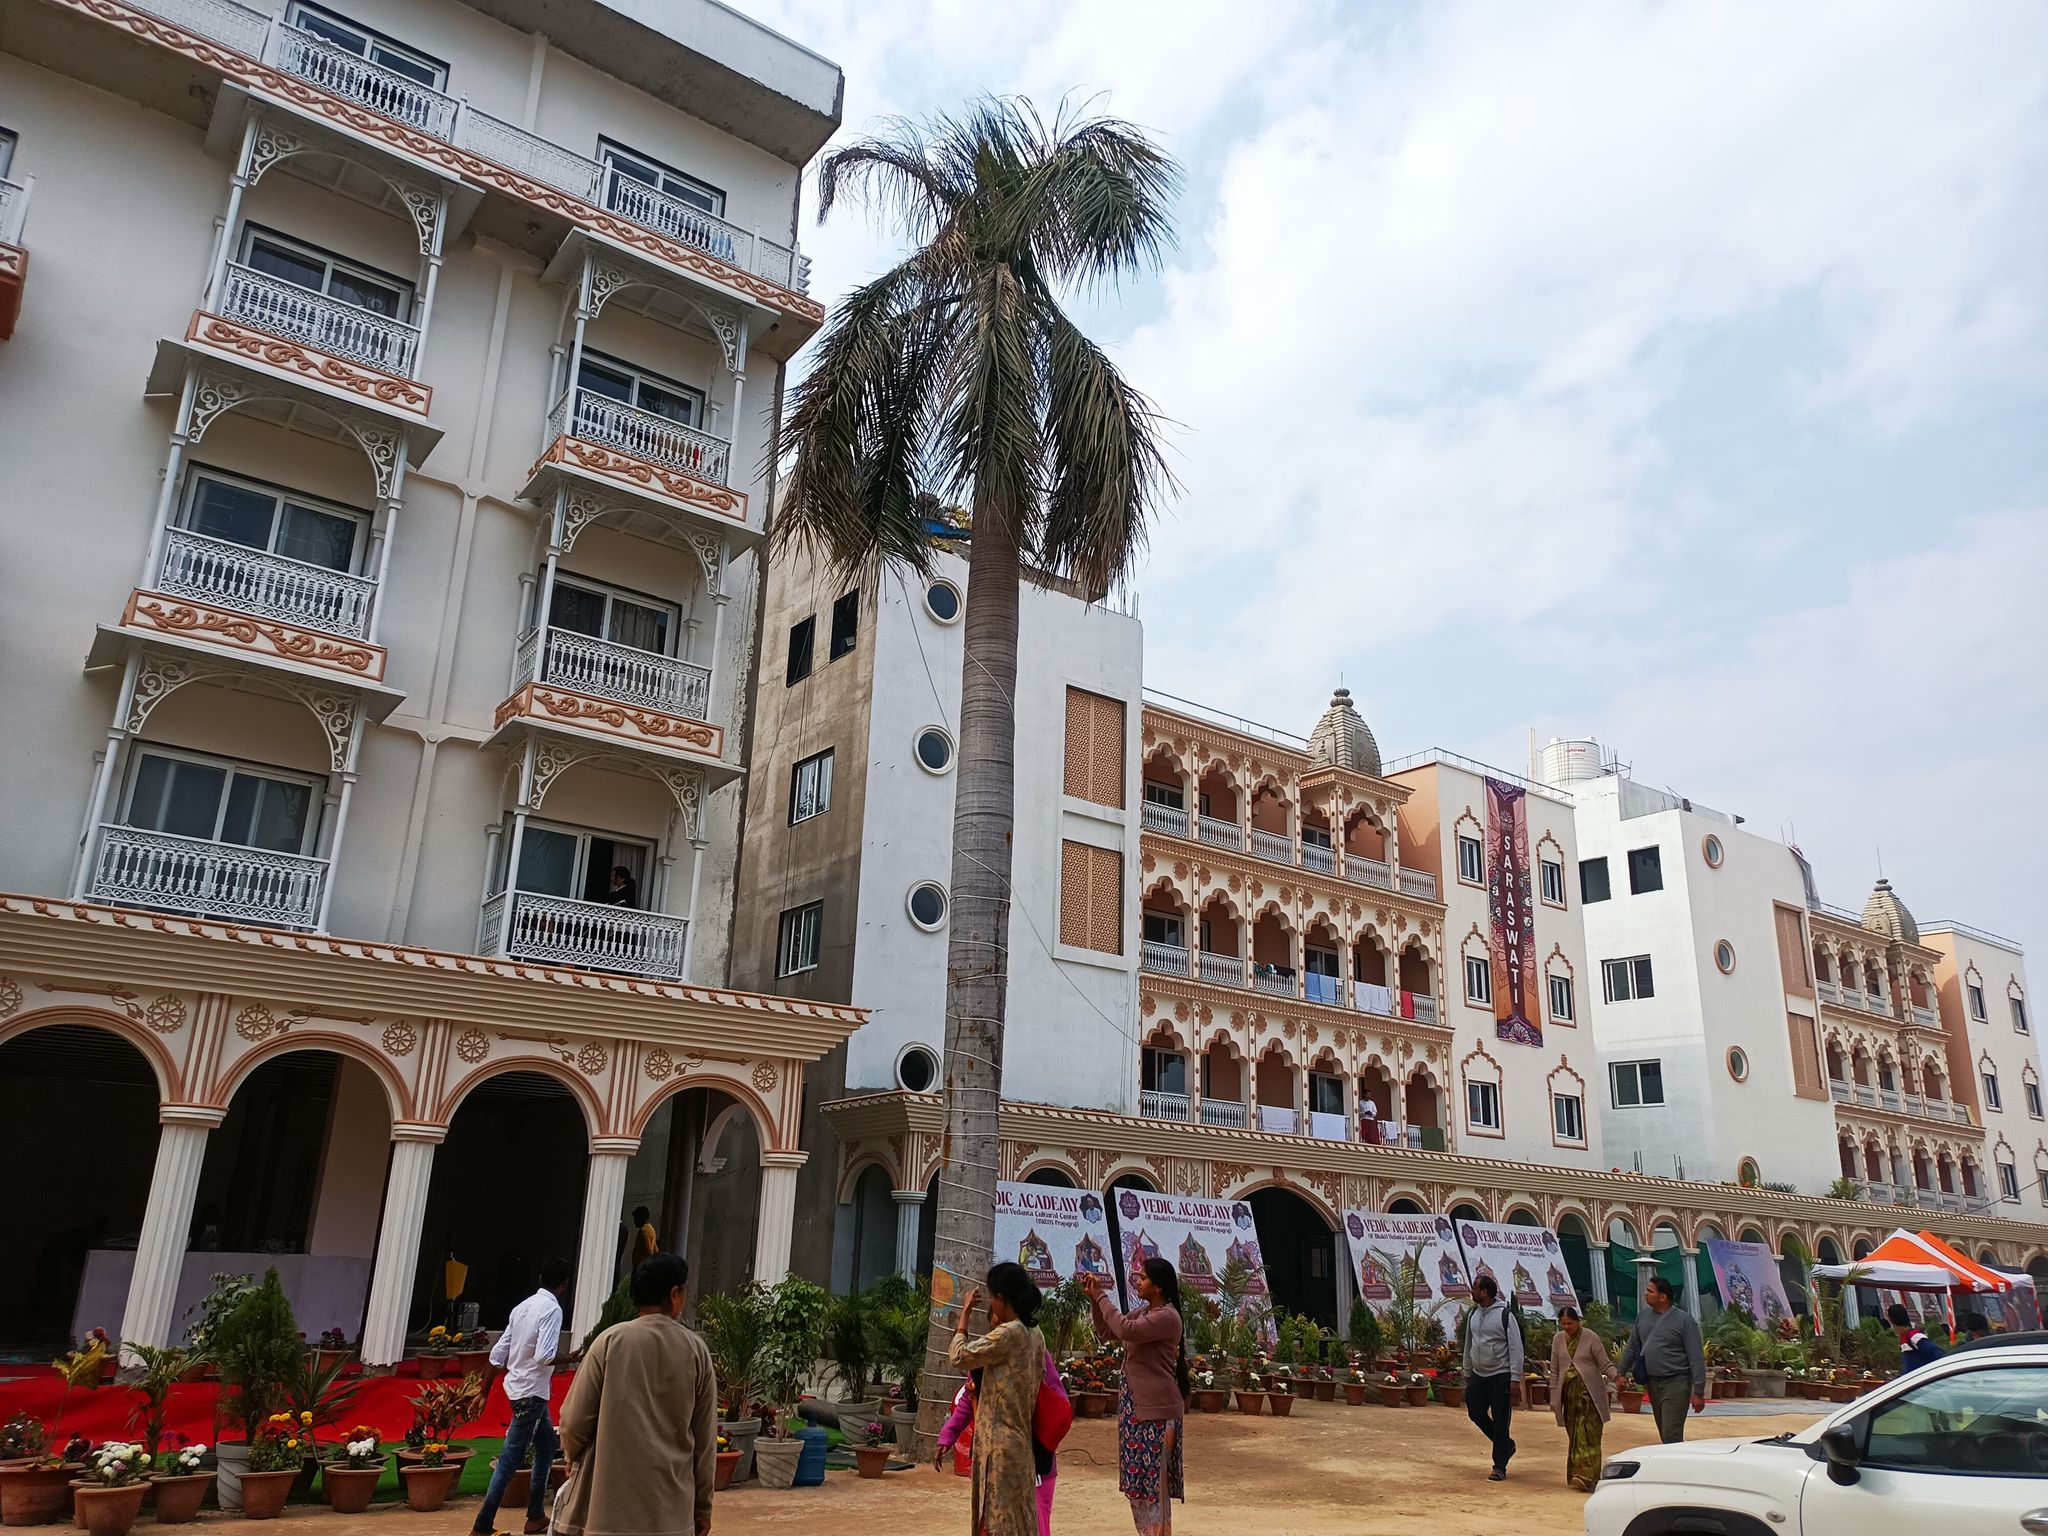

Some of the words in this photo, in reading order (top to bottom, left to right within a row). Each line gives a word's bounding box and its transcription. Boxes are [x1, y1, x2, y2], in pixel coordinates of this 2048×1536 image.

[1503, 835, 1519, 1004] SARASWATI
[1019, 1193, 1078, 1213] ACADEMY
[1140, 1198, 1175, 1214] VEDIC
[1179, 1202, 1231, 1220] ACADEMY
[1363, 1219, 1391, 1233] VEDIC
[1392, 1220, 1435, 1234] ACADEMY
[1476, 1229, 1502, 1243] VEDIC
[1504, 1232, 1542, 1246] ACADEMY
